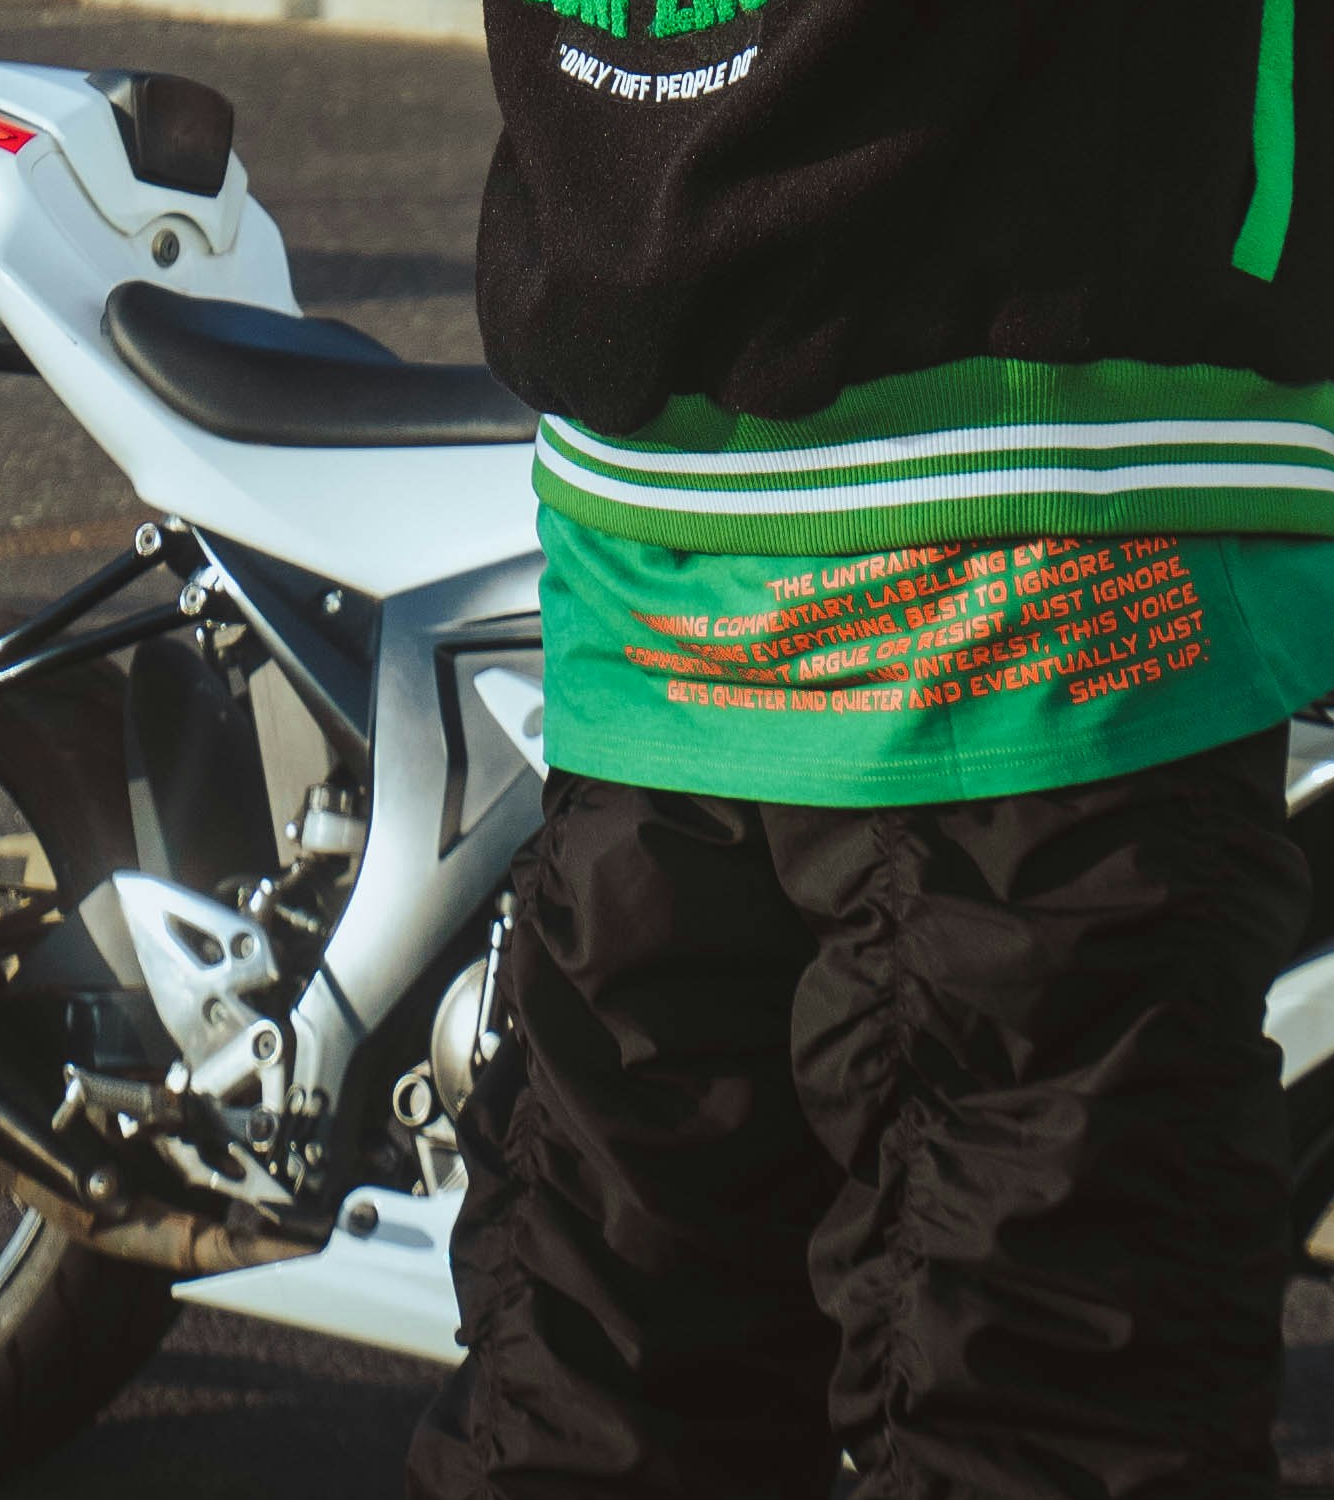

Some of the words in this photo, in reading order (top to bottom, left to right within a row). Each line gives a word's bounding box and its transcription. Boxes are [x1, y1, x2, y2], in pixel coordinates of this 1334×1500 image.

[560, 43, 612, 89] "ONLY
[610, 67, 652, 101] TUFF
[655, 61, 728, 102] PEOPLE
[713, 594, 864, 638] COMMENTARY,
[865, 550, 1007, 609] LABELLING
[751, 614, 903, 663] EVERYTHING.
[905, 590, 969, 630] BEST
[974, 580, 1008, 608] TO
[1014, 549, 1115, 597] IGNORE
[768, 573, 815, 601] THE
[822, 542, 961, 590] UNTRAINED
[667, 680, 710, 706] GETS
[712, 685, 786, 711] QUIETER
[830, 689, 903, 715] QUIETER
[908, 682, 962, 710] AND
[969, 633, 1138, 698] EVENTUALLY
[1148, 610, 1204, 650] JUST
[798, 645, 872, 681] ARGUE
[876, 636, 912, 660] OR
[1020, 588, 1084, 626] JUST
[1092, 556, 1190, 605] IGNORE.
[912, 632, 1050, 680] INTEREST,
[1054, 610, 1117, 645] THIS
[1123, 582, 1199, 624] VOICE
[1069, 658, 1162, 705] SHUTS
